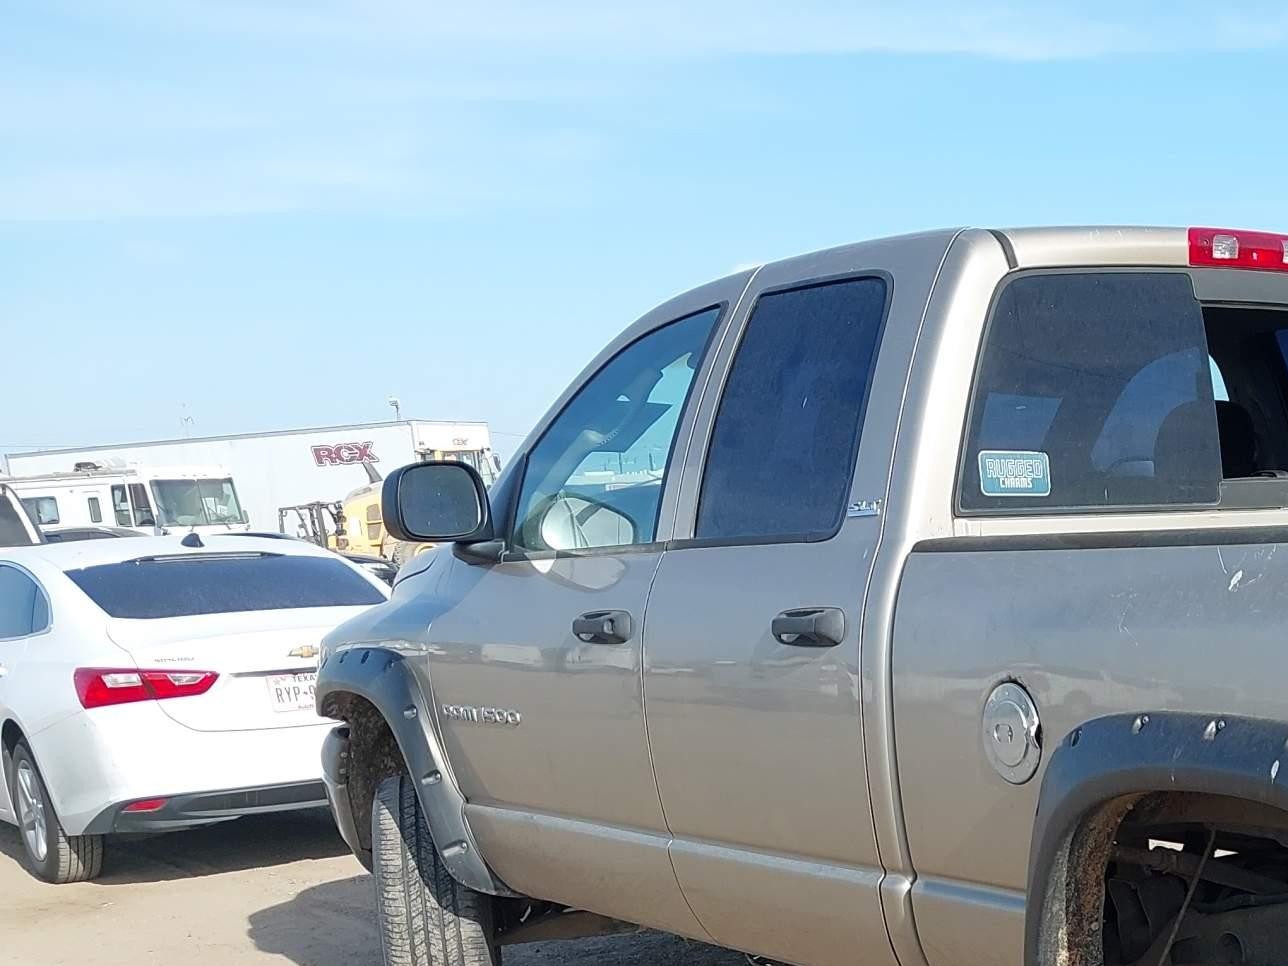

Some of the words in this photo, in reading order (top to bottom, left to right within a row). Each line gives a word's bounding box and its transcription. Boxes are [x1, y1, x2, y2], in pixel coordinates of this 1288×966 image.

[985, 458, 1043, 478] RUGGED
[999, 477, 1033, 488] CHARMS
[480, 705, 522, 726] 1500
